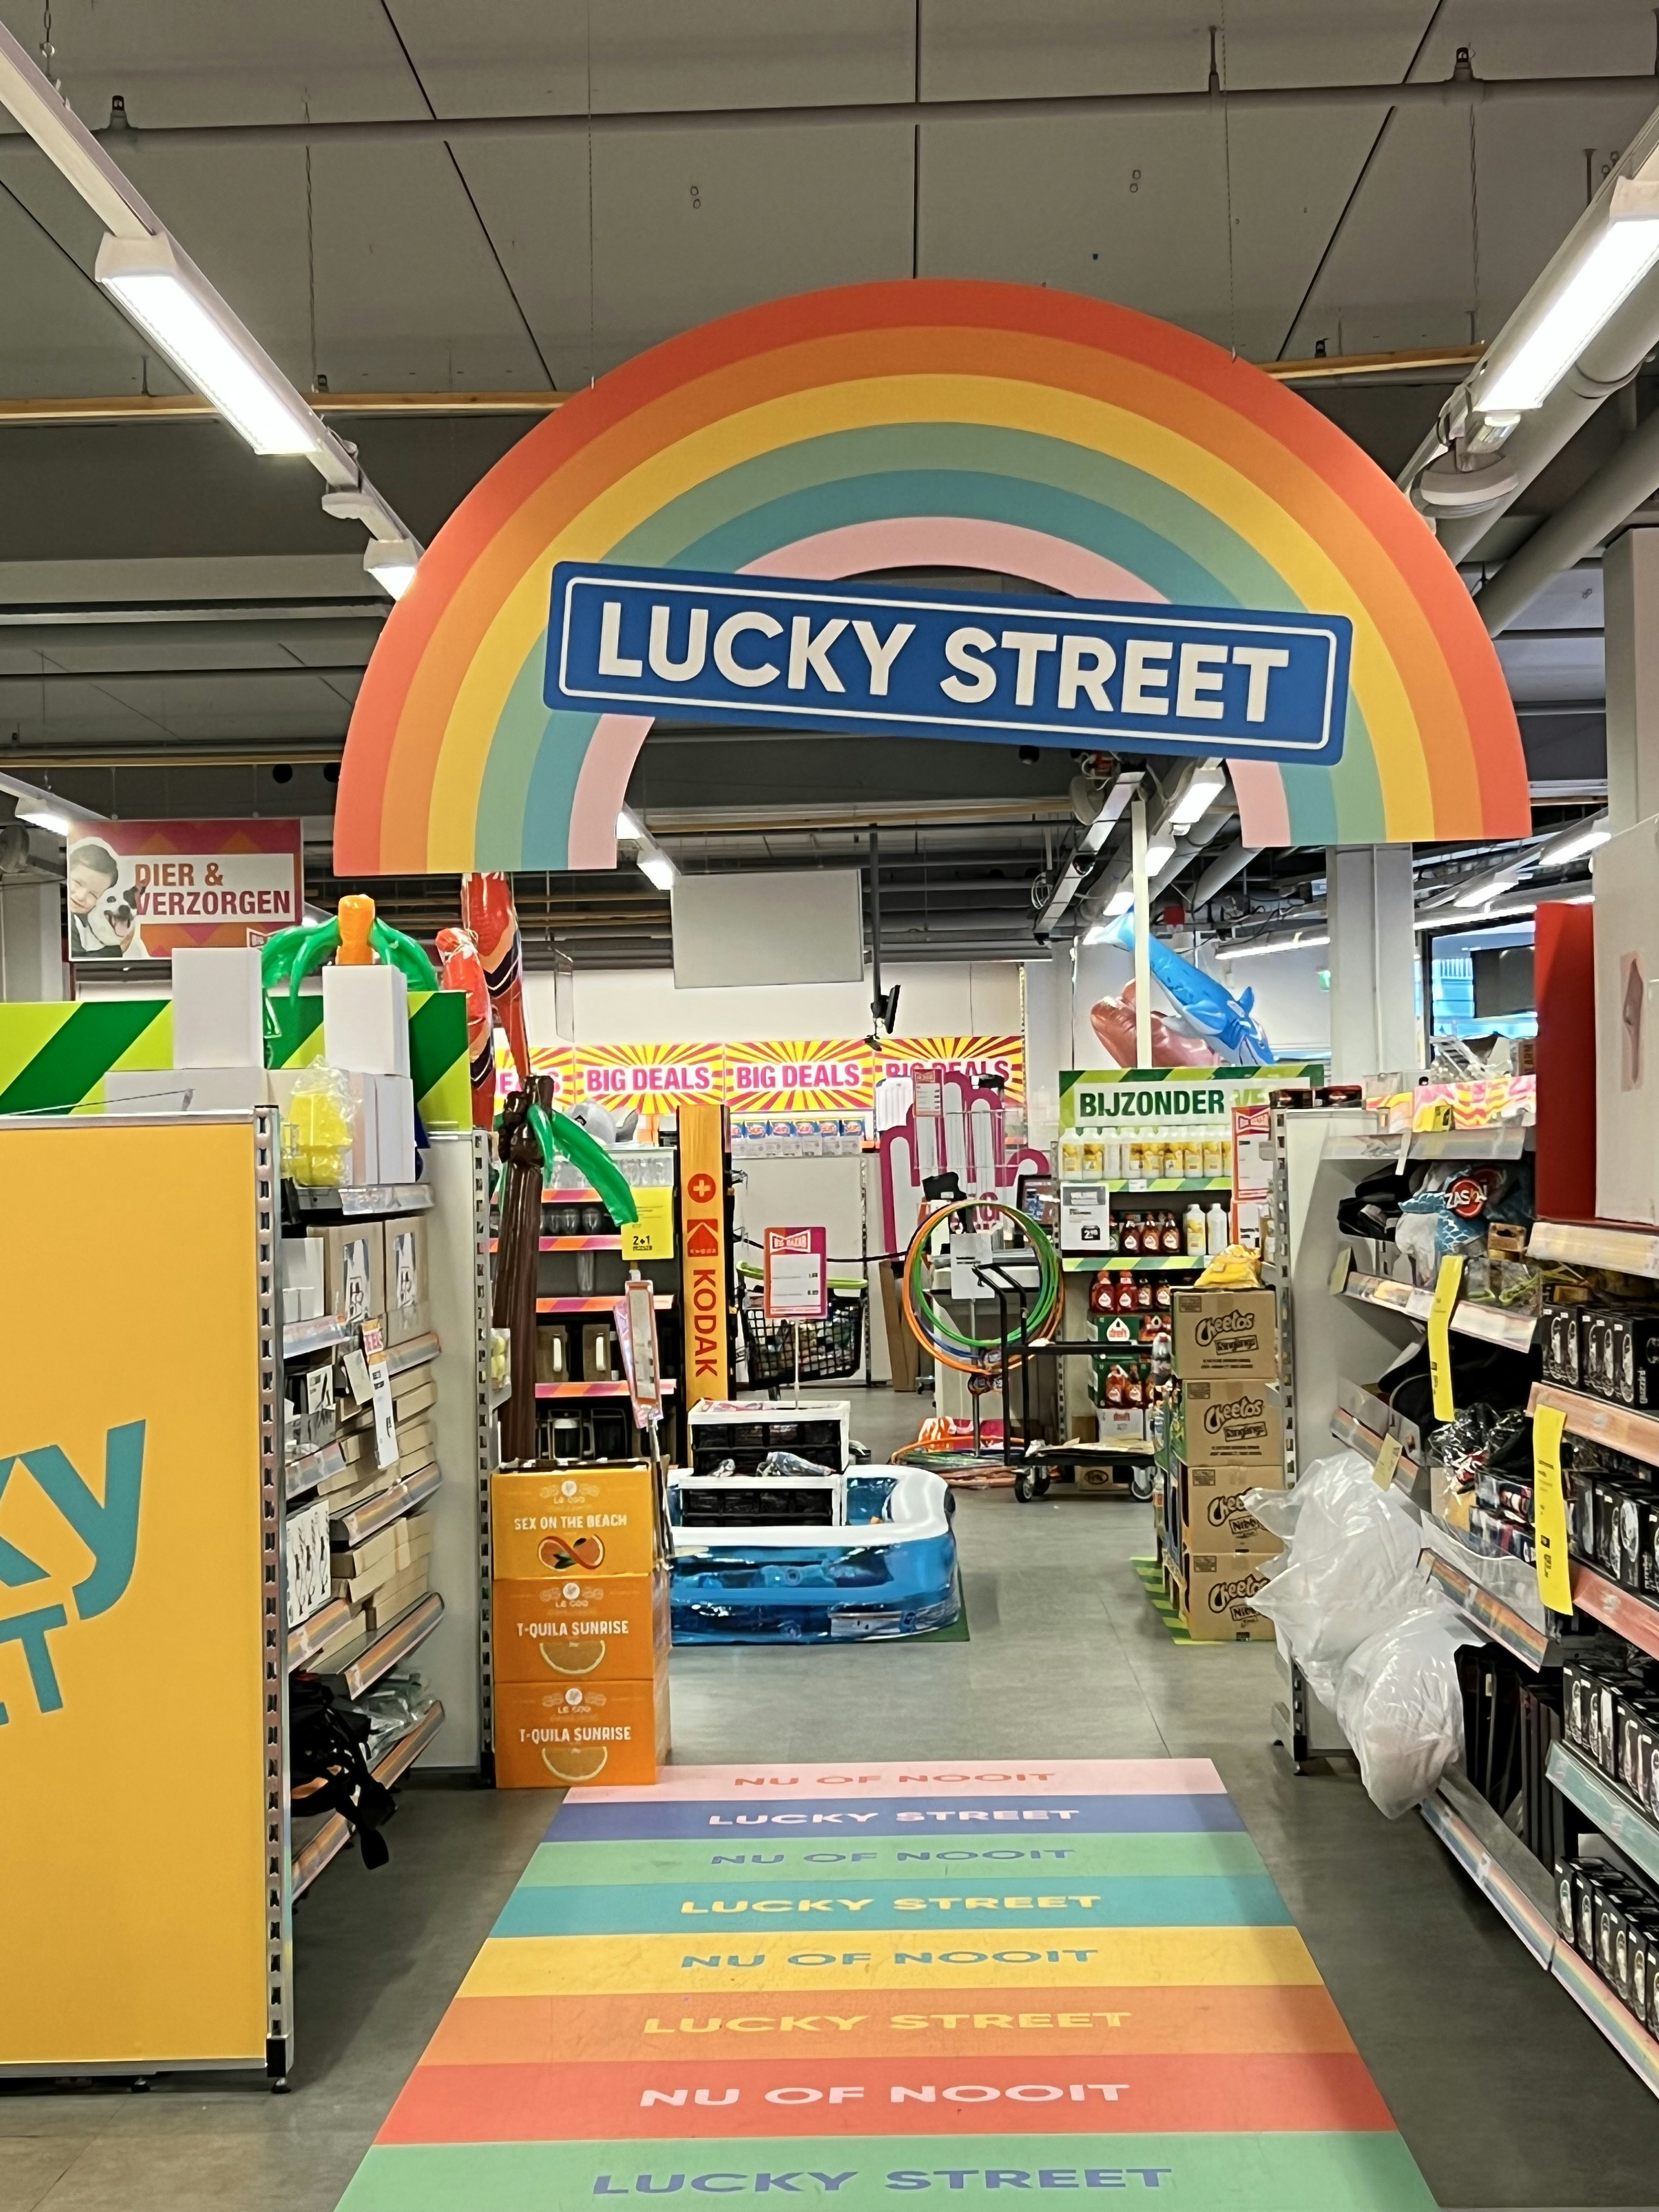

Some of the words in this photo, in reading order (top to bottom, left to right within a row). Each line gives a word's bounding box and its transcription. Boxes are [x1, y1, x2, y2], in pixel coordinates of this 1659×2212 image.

[599, 602, 916, 696] LUCKY
[940, 627, 1289, 722] STREET
[136, 864, 194, 887] DIER
[204, 862, 224, 886] &
[137, 890, 290, 916] VERZORGEN
[588, 1069, 625, 1091] BIG
[633, 1067, 709, 1090] DEALS
[737, 1066, 776, 1088] BIG
[782, 1064, 860, 1087] DEALS
[1080, 1090, 1224, 1117] BIJZONDER
[693, 1269, 718, 1377] KODAK
[1195, 1310, 1255, 1347] Cheetos
[1204, 1396, 1263, 1434] Cheetos
[1207, 1487, 1251, 1527] Chee
[515, 1517, 536, 1530] SEX
[540, 1516, 556, 1529] ON
[561, 1515, 583, 1528] THE
[587, 1514, 627, 1528] BEACH
[1208, 1574, 1271, 1613] Cheeto
[517, 1622, 567, 1638] T-QUILA
[572, 1621, 629, 1635] SUNRISE
[520, 1728, 569, 1744] T-QUILA
[574, 1726, 631, 1741] SUNRISE
[817, 1775, 881, 1784] OF
[899, 1773, 1055, 1782] NOOIT
[709, 1813, 878, 1825] LUCKY
[896, 1810, 1079, 1821] STREET
[711, 1855, 785, 1864] NU
[803, 1853, 877, 1862] OF
[897, 1849, 1075, 1861] NOOIT
[681, 1898, 874, 1914] LUCKY
[893, 1896, 1101, 1910] STREET
[681, 1954, 765, 1967] NU
[788, 1953, 871, 1965] OF
[895, 1950, 1098, 1963] NOOIT
[644, 2016, 868, 2033] LUCKY
[890, 2012, 1132, 2029] STREET
[640, 2089, 740, 2107] NU
[765, 2087, 865, 2104] OF
[891, 2084, 1130, 2103] NOOIT
[593, 2171, 859, 2194] LUCKY
[885, 2169, 1172, 2190] STREET
